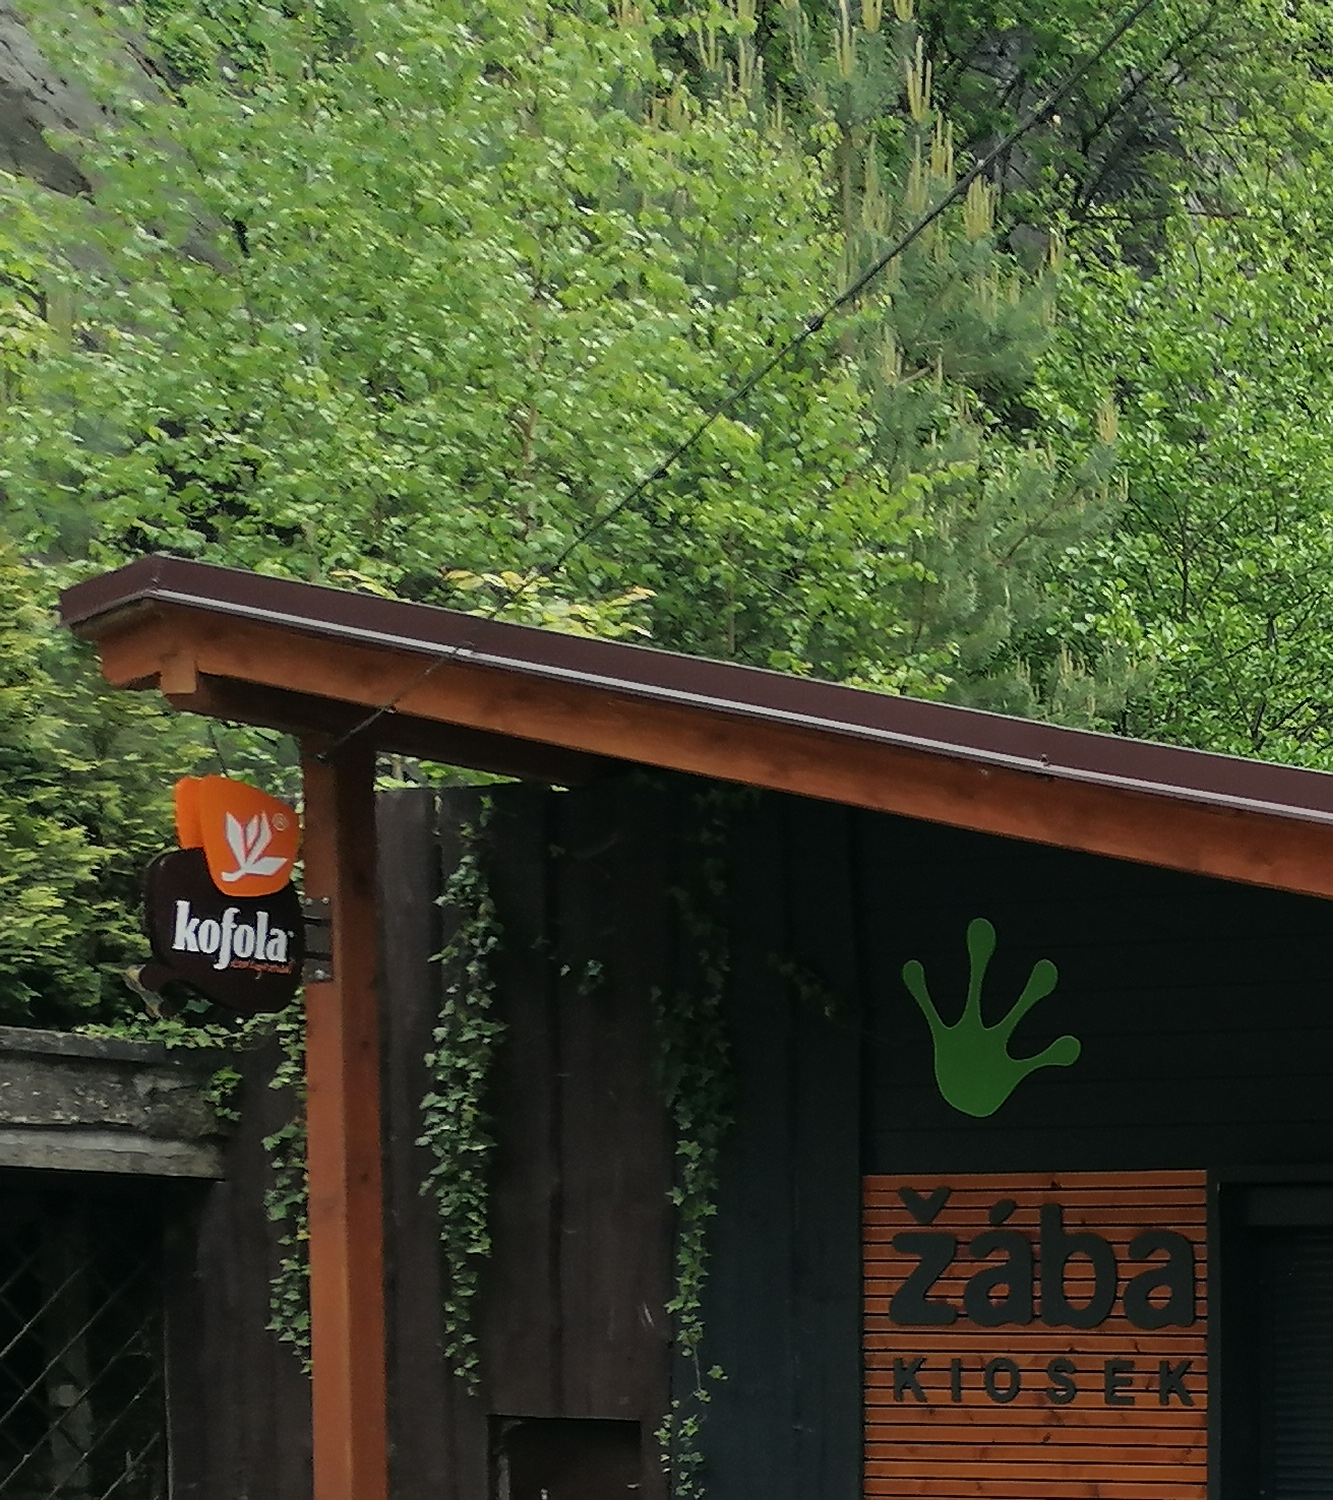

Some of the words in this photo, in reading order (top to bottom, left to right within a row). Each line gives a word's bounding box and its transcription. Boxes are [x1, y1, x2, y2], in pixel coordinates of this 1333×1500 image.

[172, 900, 288, 970] kofola
[889, 1186, 1196, 1330] žába
[892, 1357, 1195, 1406] KIOSEK
